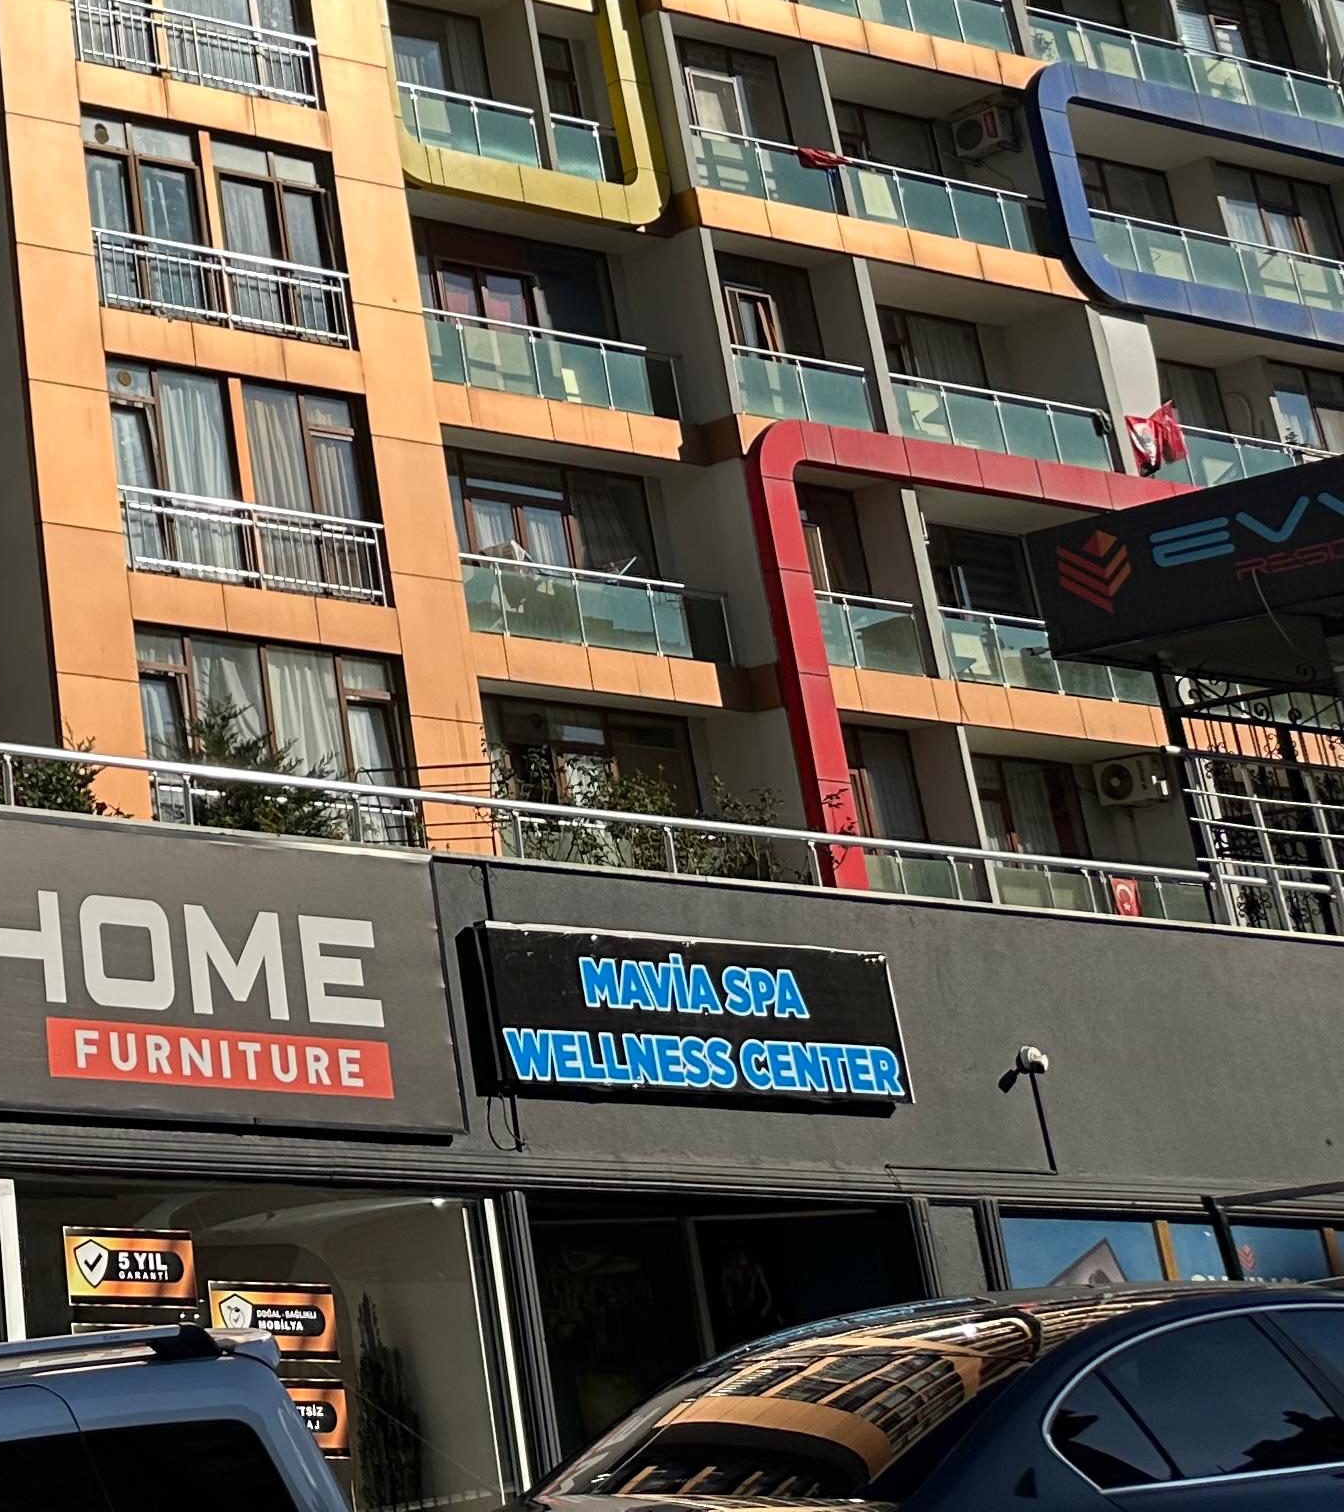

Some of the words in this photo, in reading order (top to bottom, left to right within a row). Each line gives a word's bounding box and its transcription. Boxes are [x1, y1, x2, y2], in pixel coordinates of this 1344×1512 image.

[579, 953, 723, 1015] MAVİA
[724, 966, 810, 1019] SPA
[74, 1029, 364, 1088] FURNITURE
[503, 1027, 737, 1089] WELLNESS
[741, 1038, 906, 1096] CENTER
[118, 1252, 131, 1269] 5
[134, 1252, 168, 1271] YIL
[118, 1270, 169, 1281] GARANTİ
[258, 1319, 304, 1331] MOBİLYA
